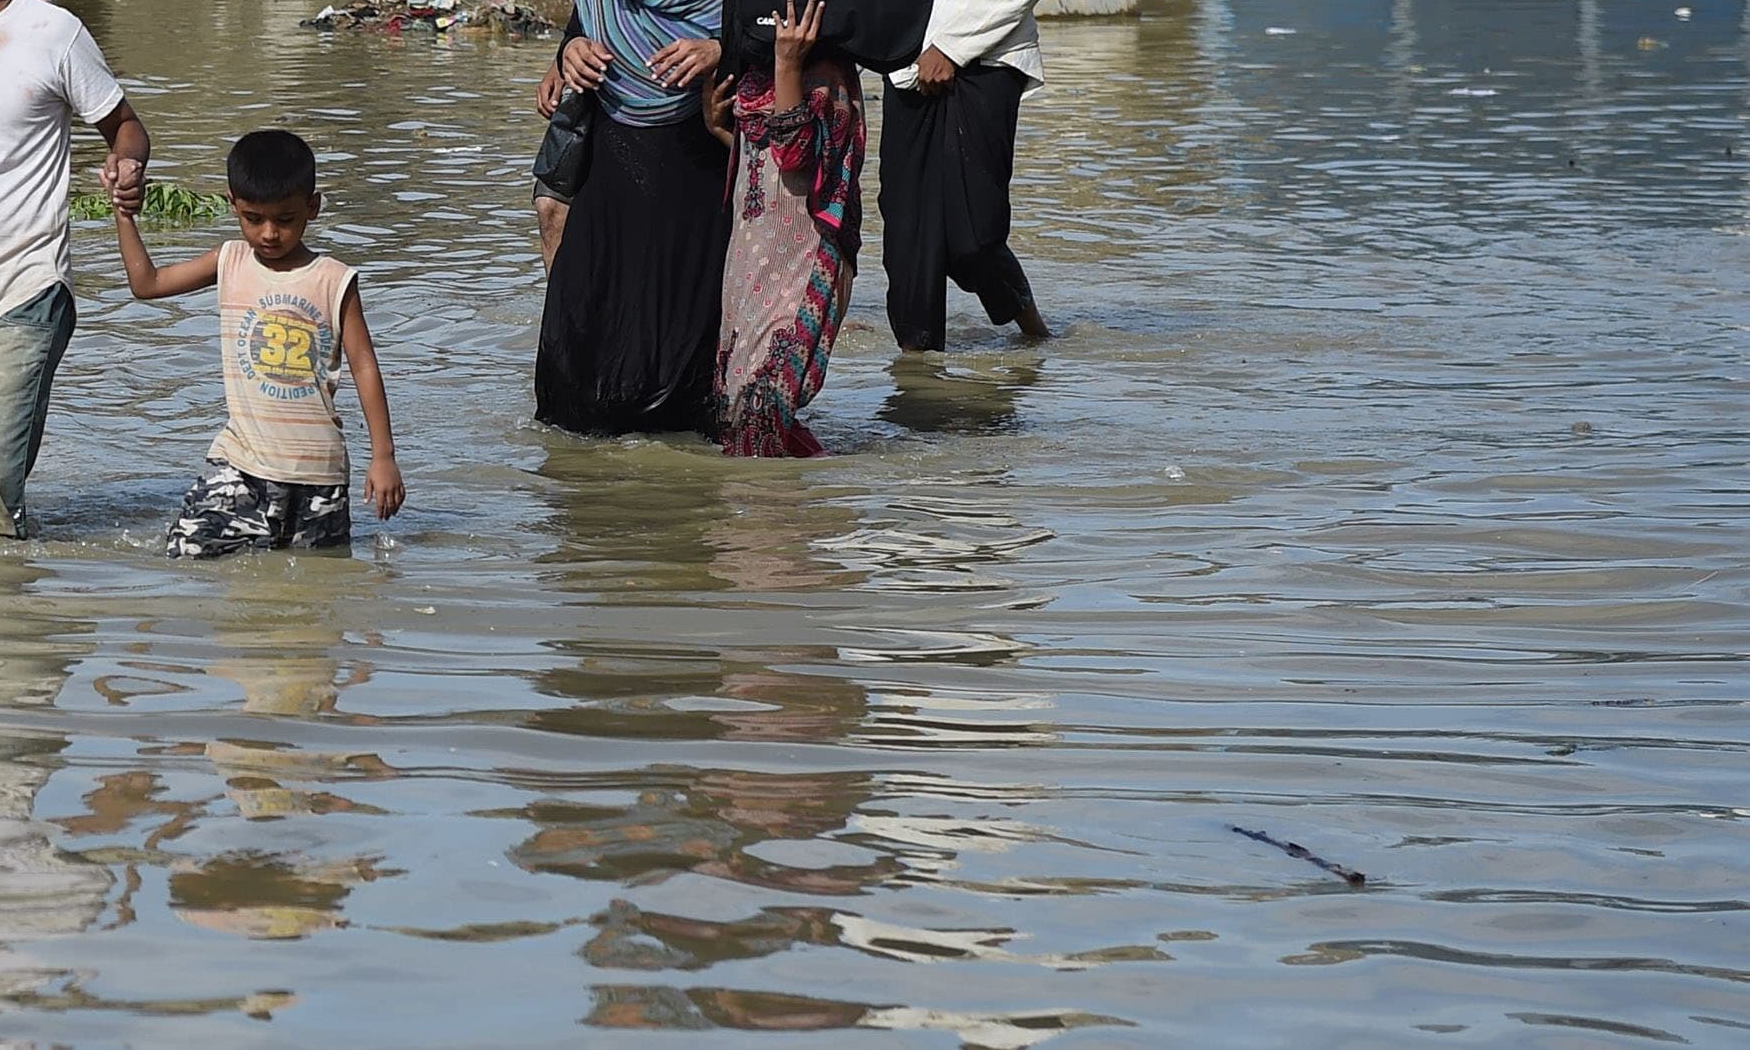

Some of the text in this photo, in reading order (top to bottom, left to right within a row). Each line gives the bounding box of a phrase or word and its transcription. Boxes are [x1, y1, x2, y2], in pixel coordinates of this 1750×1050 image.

[259, 294, 322, 322] SUBMARINE
[238, 309, 258, 348] OCEAN
[260, 323, 312, 370] 32
[238, 351, 256, 380] DEPT
